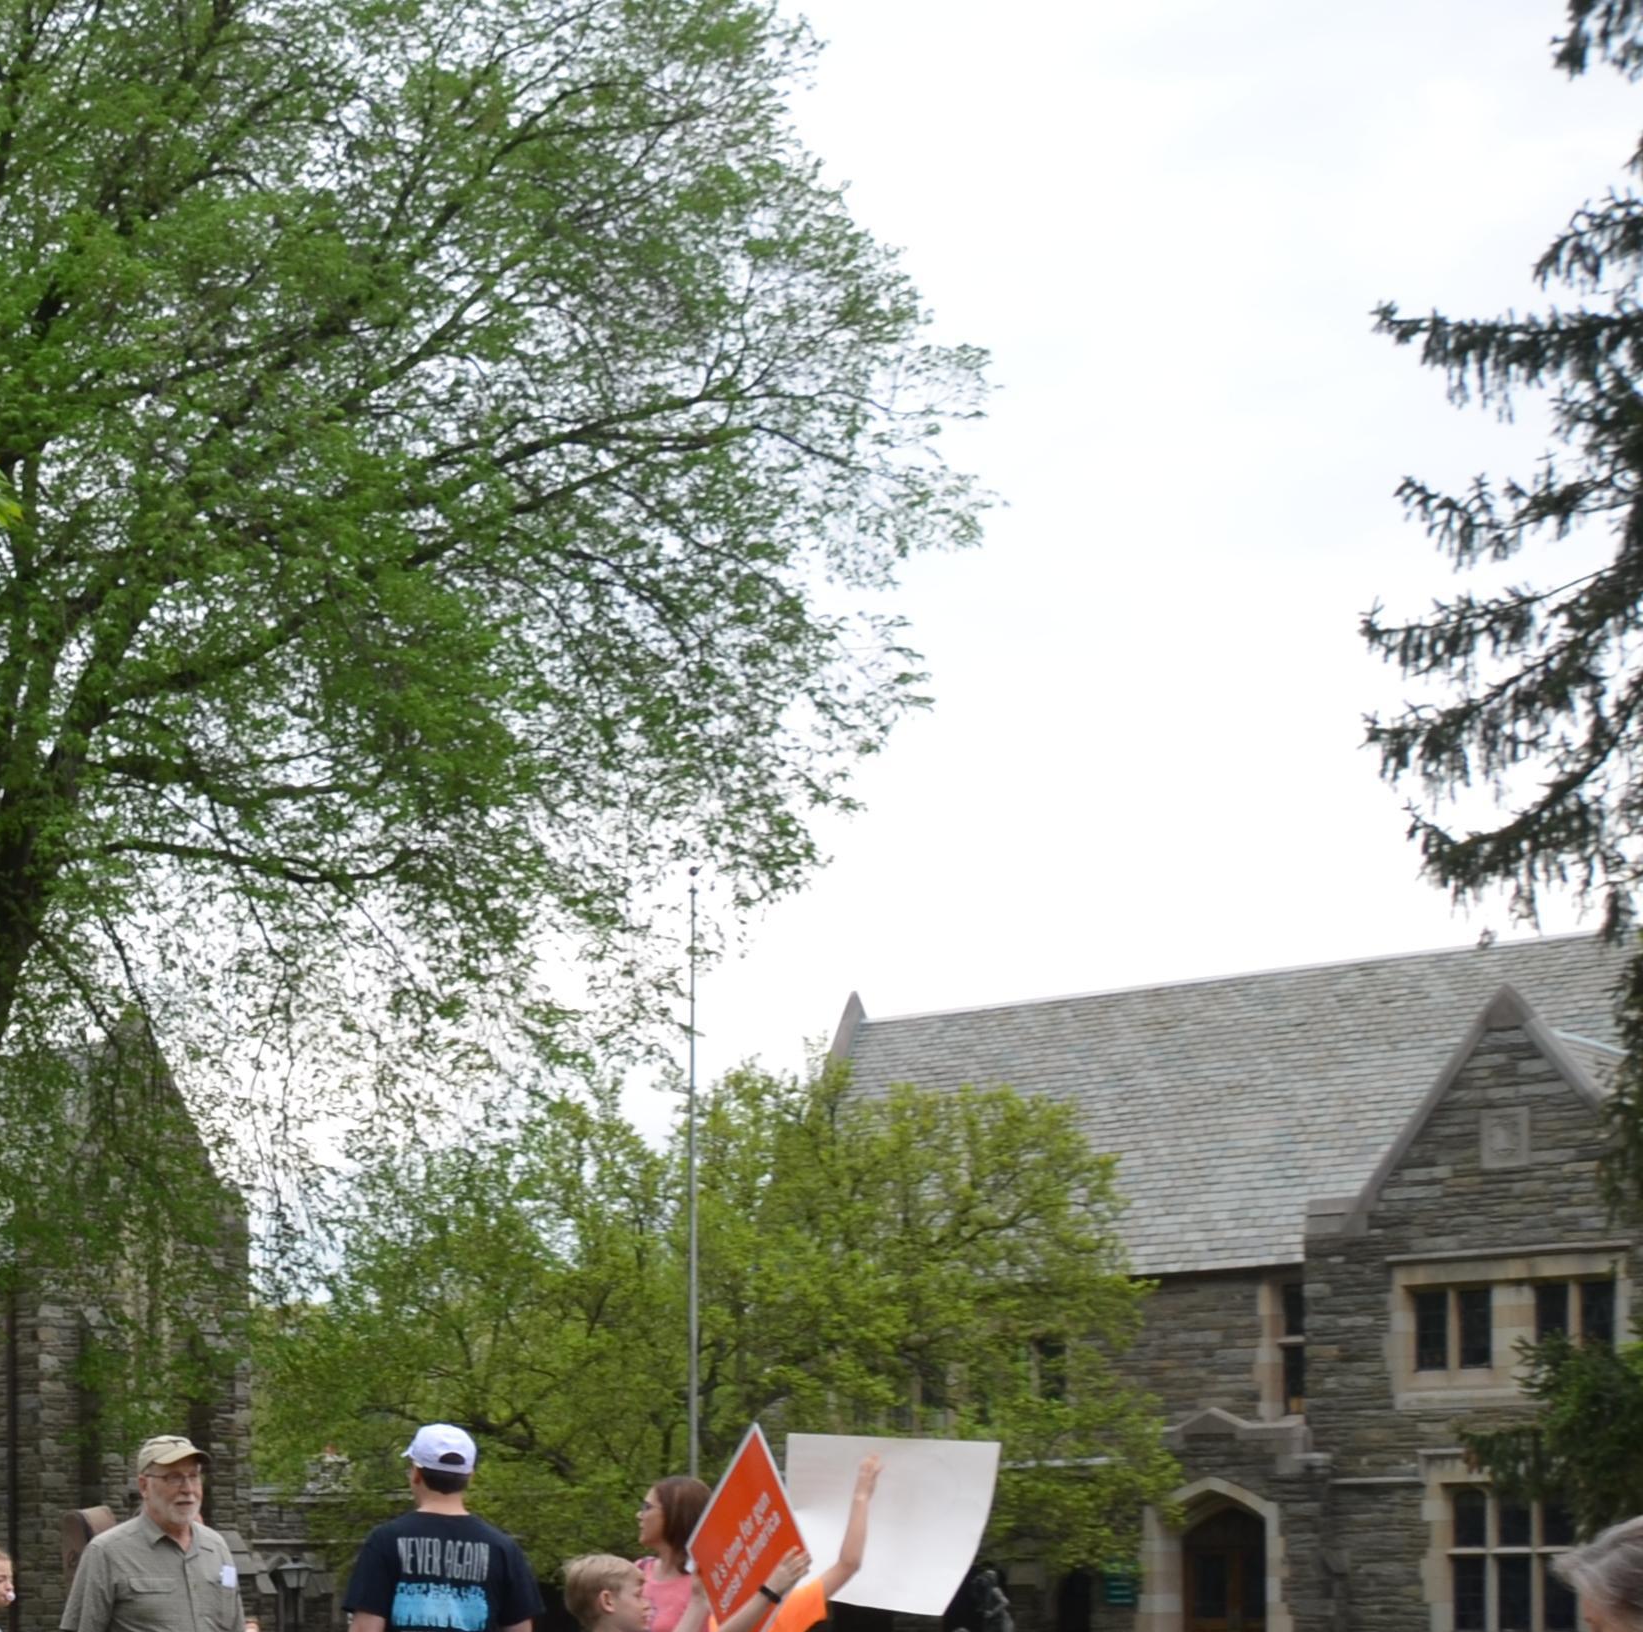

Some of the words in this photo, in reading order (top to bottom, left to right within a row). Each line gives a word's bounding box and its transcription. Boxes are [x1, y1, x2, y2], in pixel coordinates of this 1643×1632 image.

[397, 1537, 442, 1577] NEVER
[444, 1540, 490, 1583] AGAIN
[710, 1563, 728, 1590] It's
[723, 1535, 743, 1568] time
[739, 1515, 754, 1540] for
[752, 1491, 771, 1526] gun
[719, 1573, 743, 1614] sense
[738, 1560, 750, 1579] in
[745, 1510, 782, 1567] America
